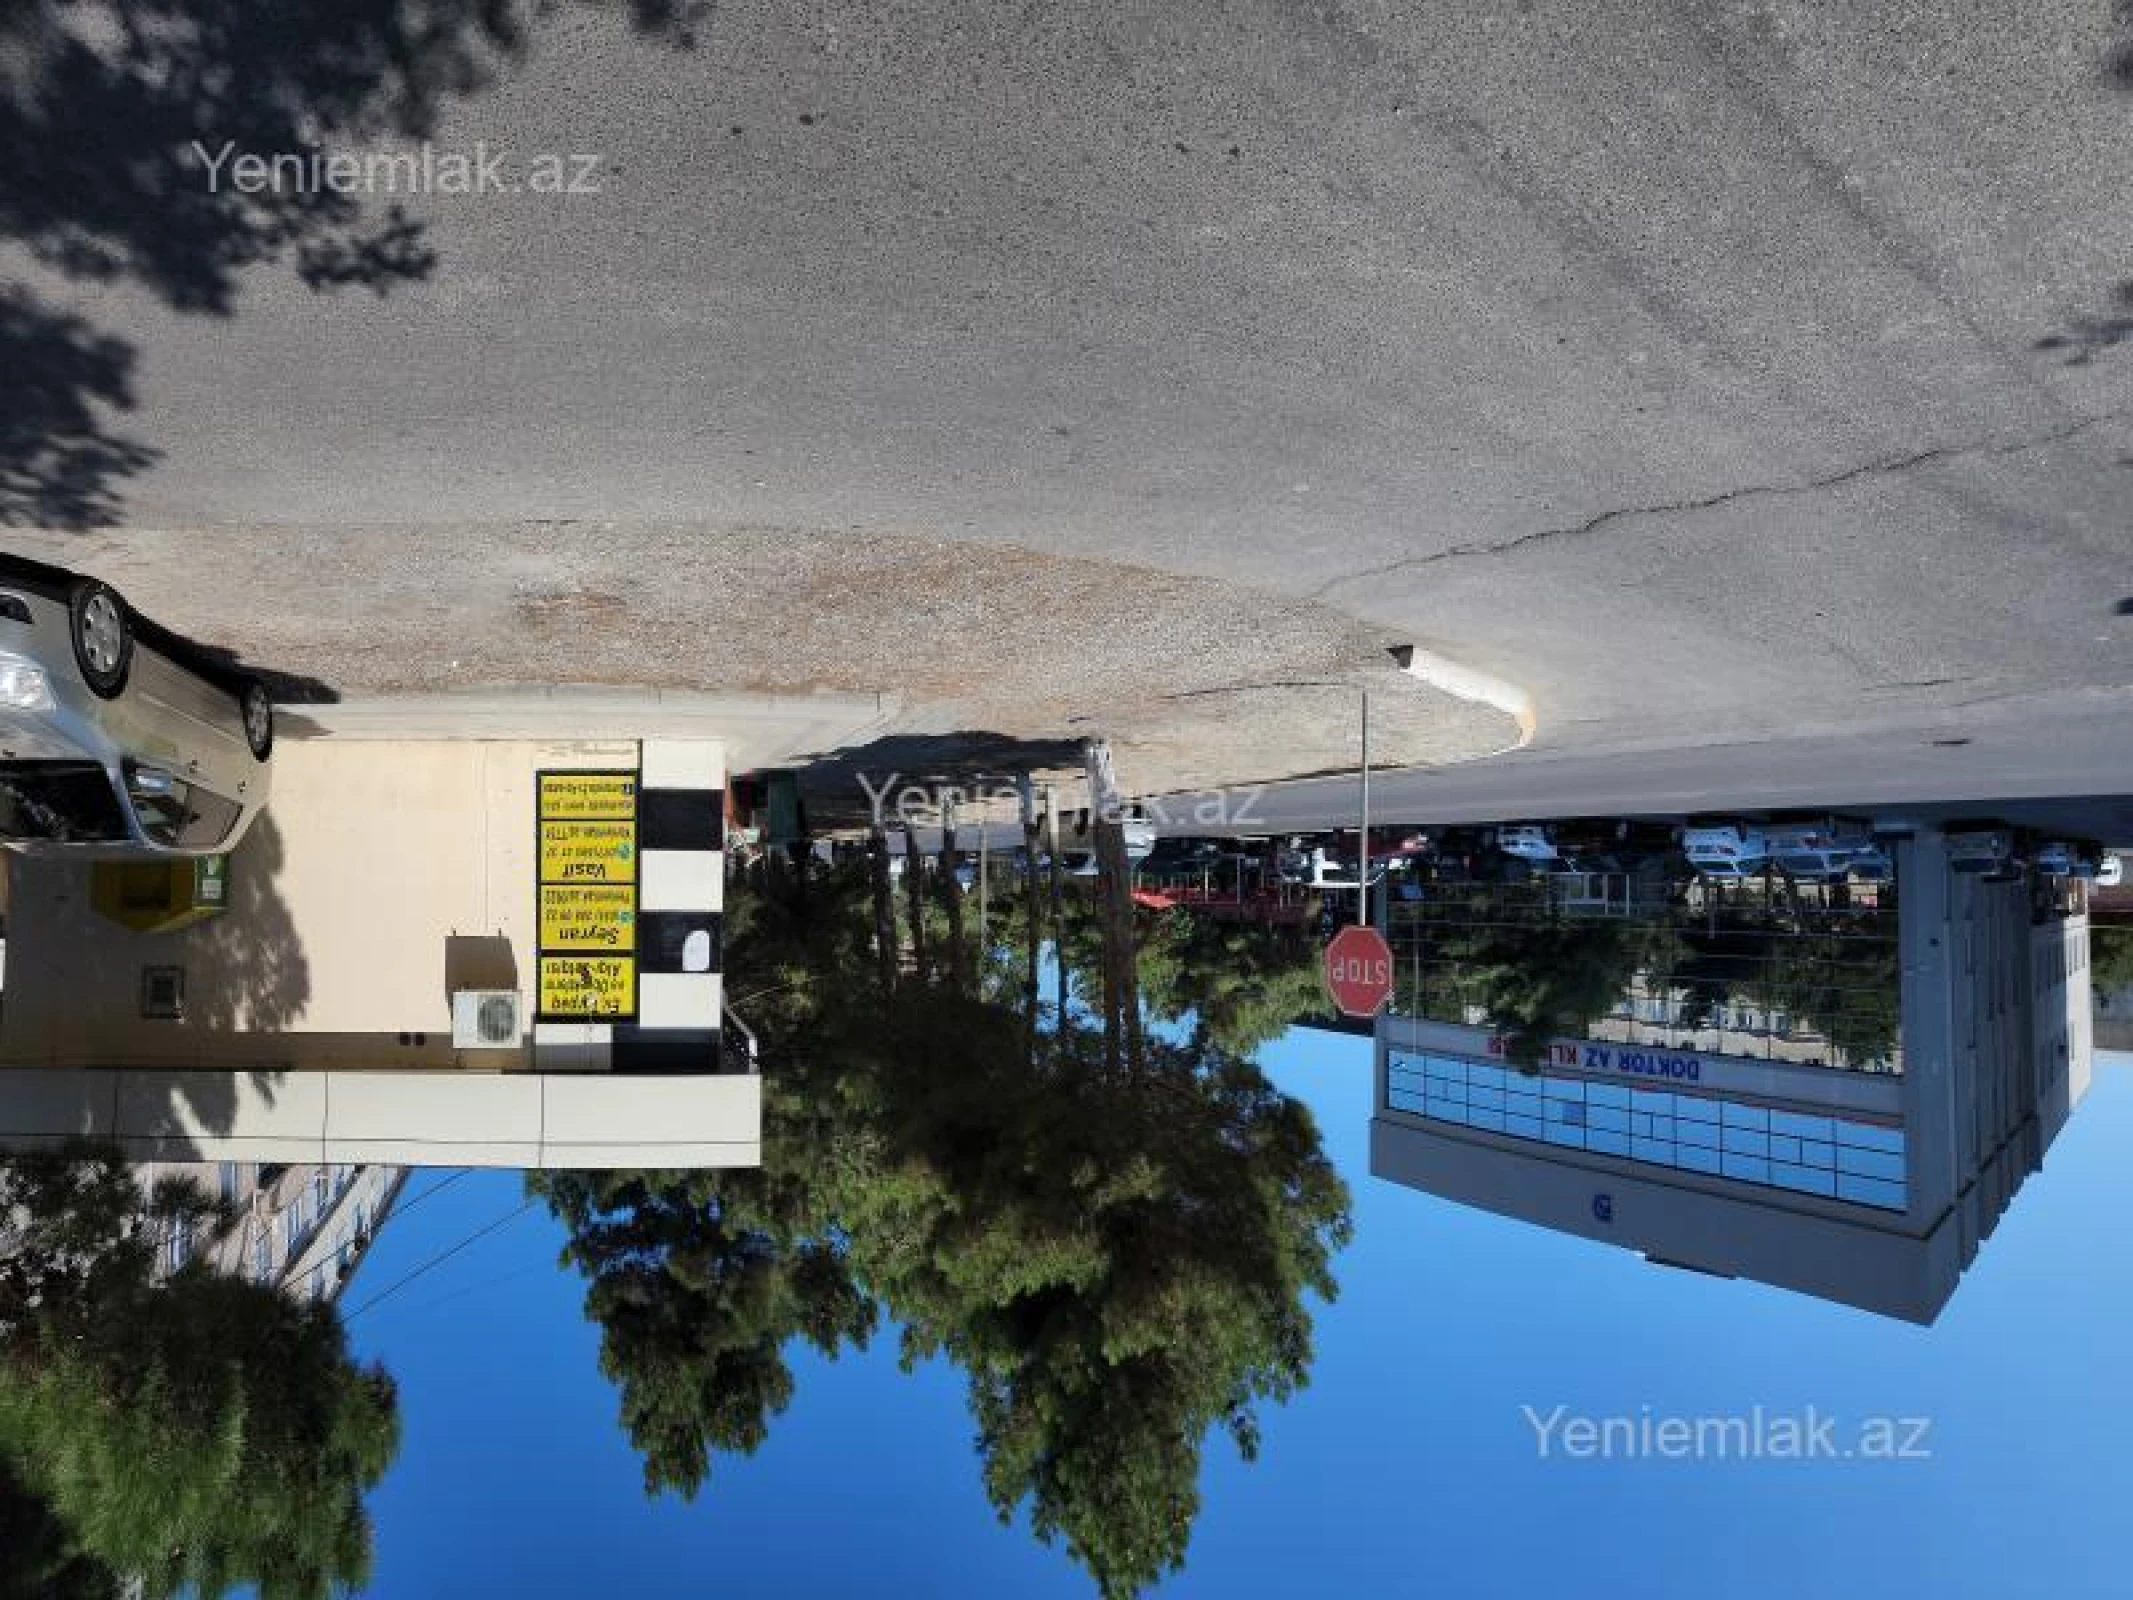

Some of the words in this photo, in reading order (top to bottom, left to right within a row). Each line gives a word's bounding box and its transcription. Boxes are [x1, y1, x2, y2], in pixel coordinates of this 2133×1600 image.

[562, 864, 605, 878] Vasif
[559, 925, 619, 945] Seyran
[1333, 957, 1388, 985] STOP
[1585, 1047, 1611, 1068] AZ
[1618, 1053, 1700, 1081] DOKTOR
